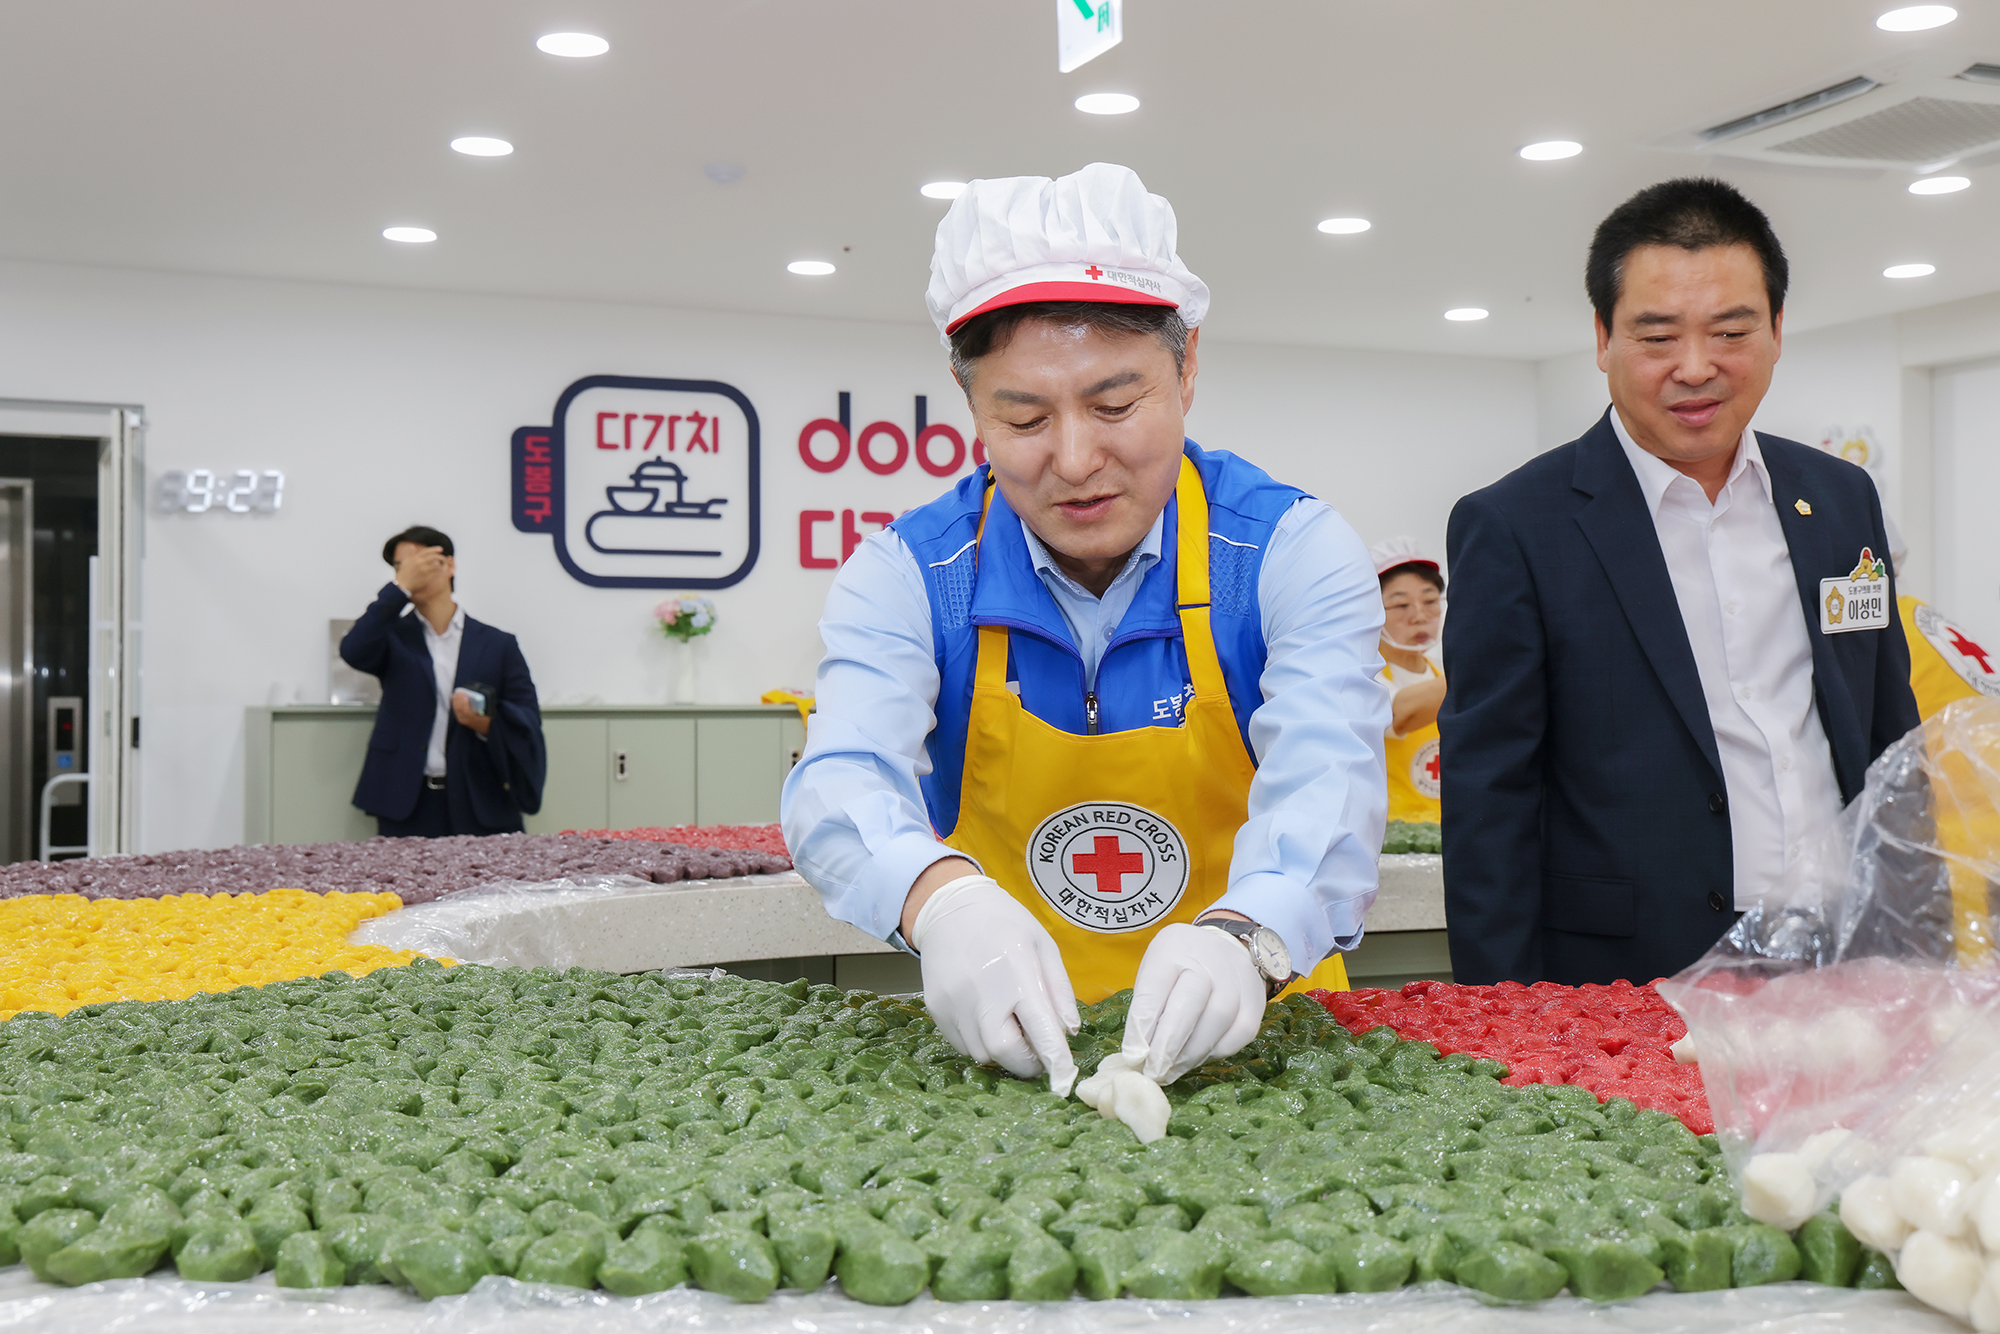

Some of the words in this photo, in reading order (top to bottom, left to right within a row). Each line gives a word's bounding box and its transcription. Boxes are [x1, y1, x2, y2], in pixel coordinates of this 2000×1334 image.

[1106, 270, 1162, 293] 대한적십자사
[596, 410, 719, 454] 다가치
[186, 469, 286, 512] 9:27
[524, 435, 552, 524] 도봉구
[1848, 598, 1882, 620] 이성민
[1039, 813, 1090, 864] KOREAN
[1093, 811, 1132, 825] RED
[1134, 818, 1177, 863] CROSS
[1058, 887, 1164, 924] 대한적십자사
